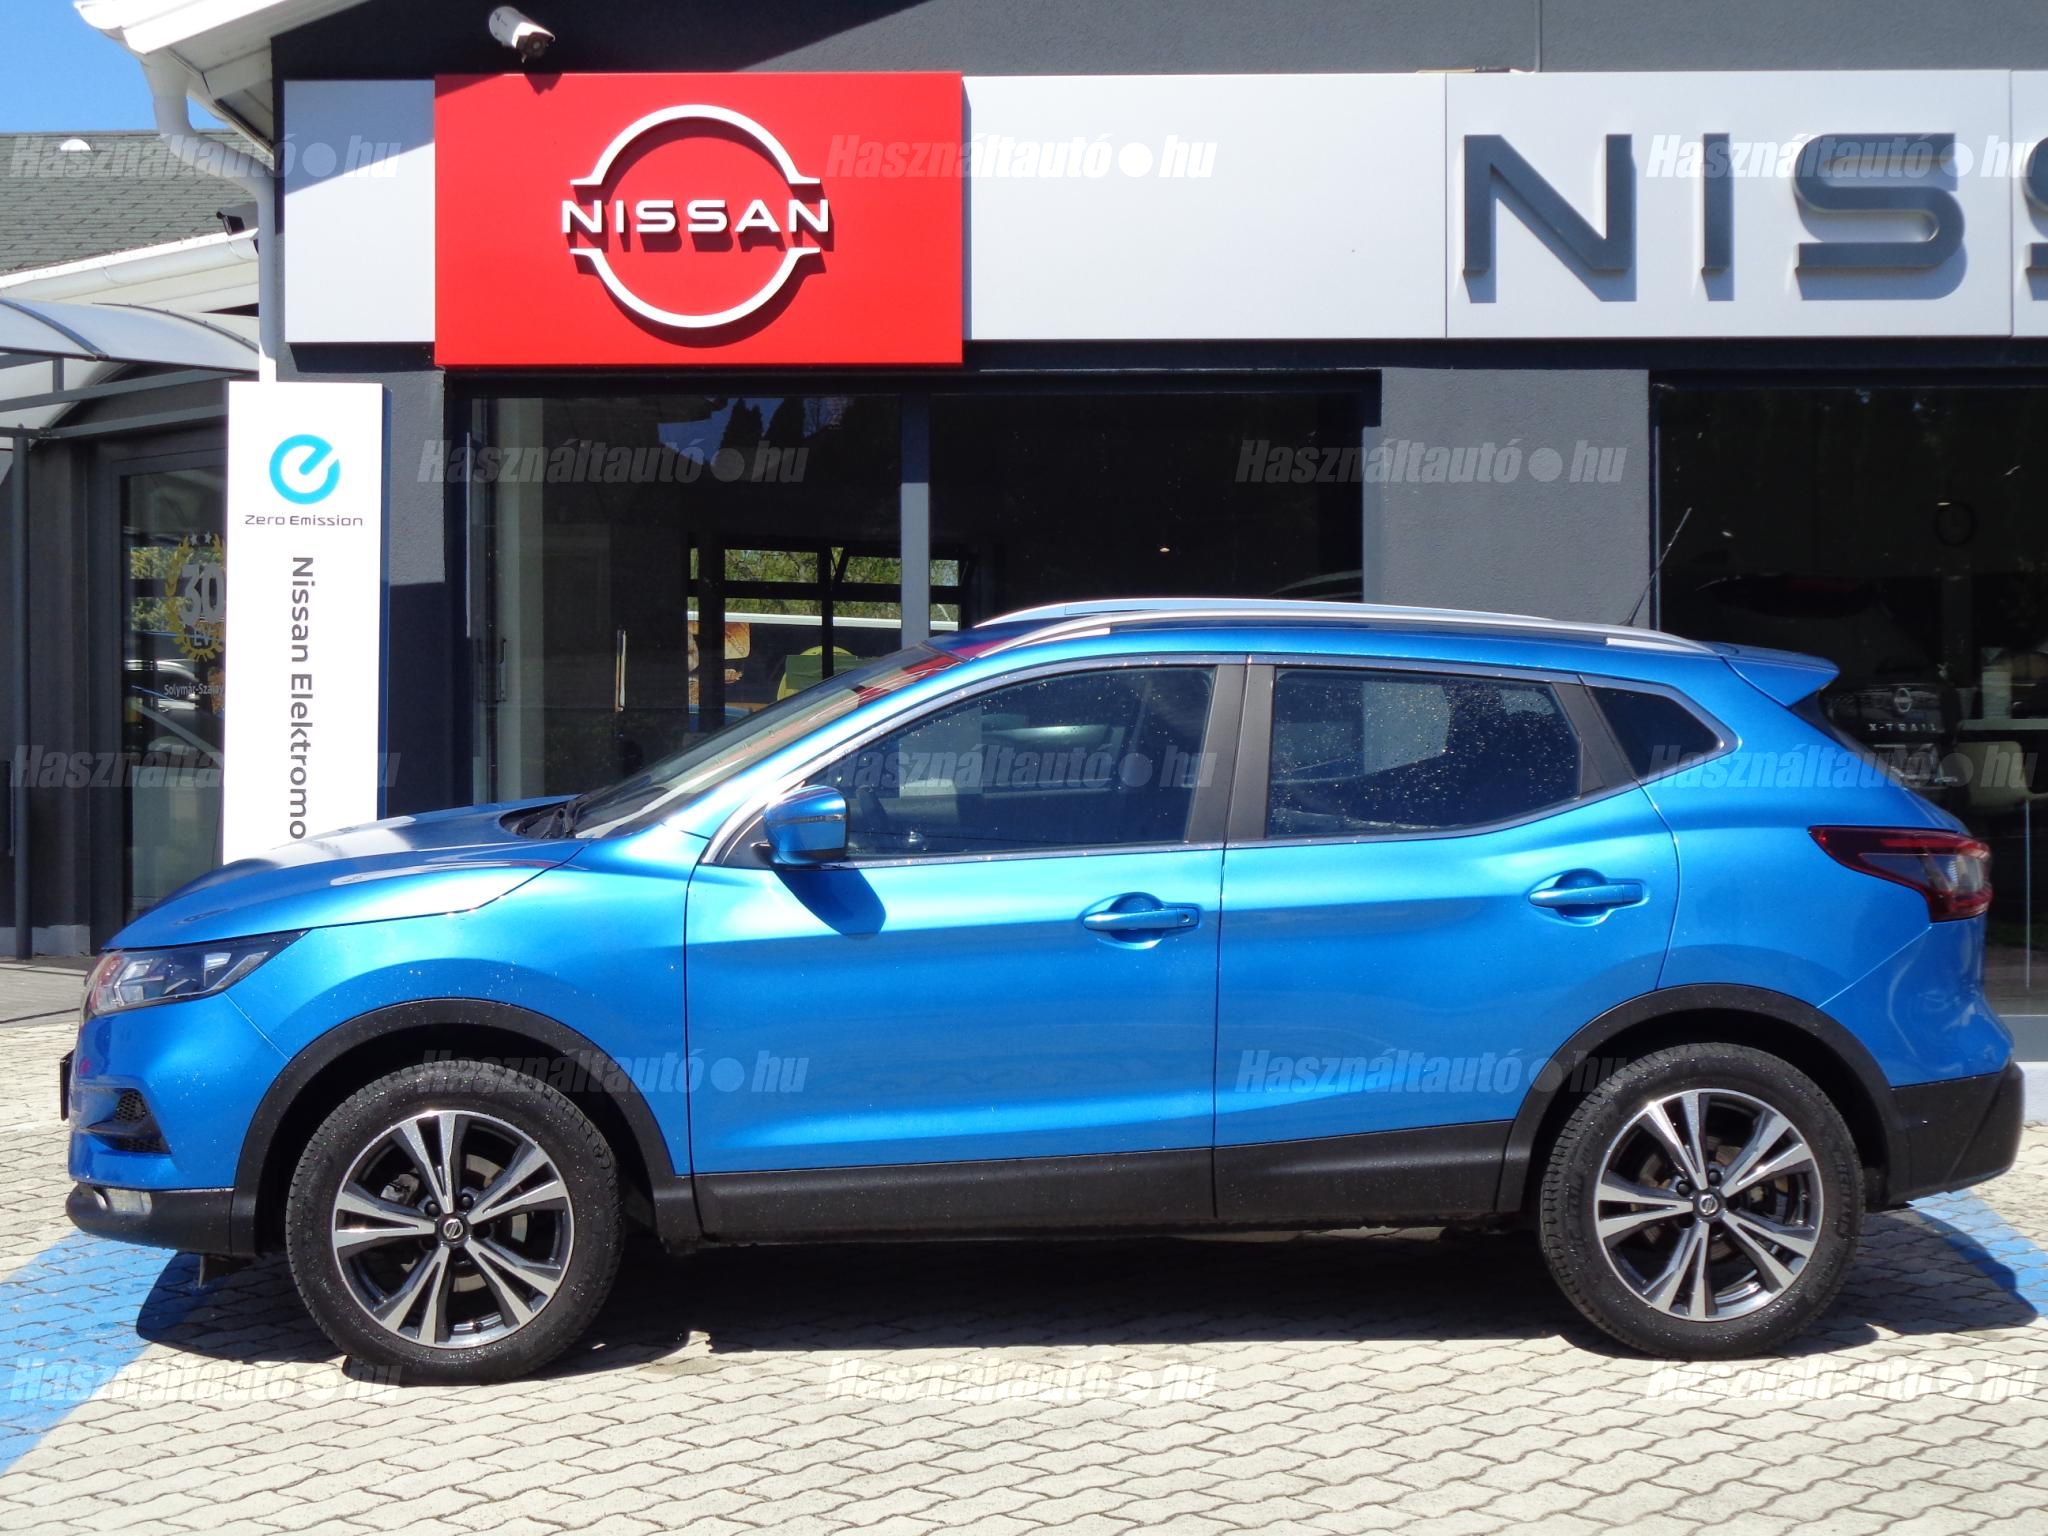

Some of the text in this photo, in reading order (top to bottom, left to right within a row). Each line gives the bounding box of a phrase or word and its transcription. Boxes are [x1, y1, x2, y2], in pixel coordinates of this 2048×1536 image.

[561, 198, 830, 234] NISSAN
[1463, 132, 2048, 271] NIS
[244, 514, 363, 527] Zero Emission
[180, 562, 226, 627] 30
[289, 556, 316, 840] Nissan Elektromo
